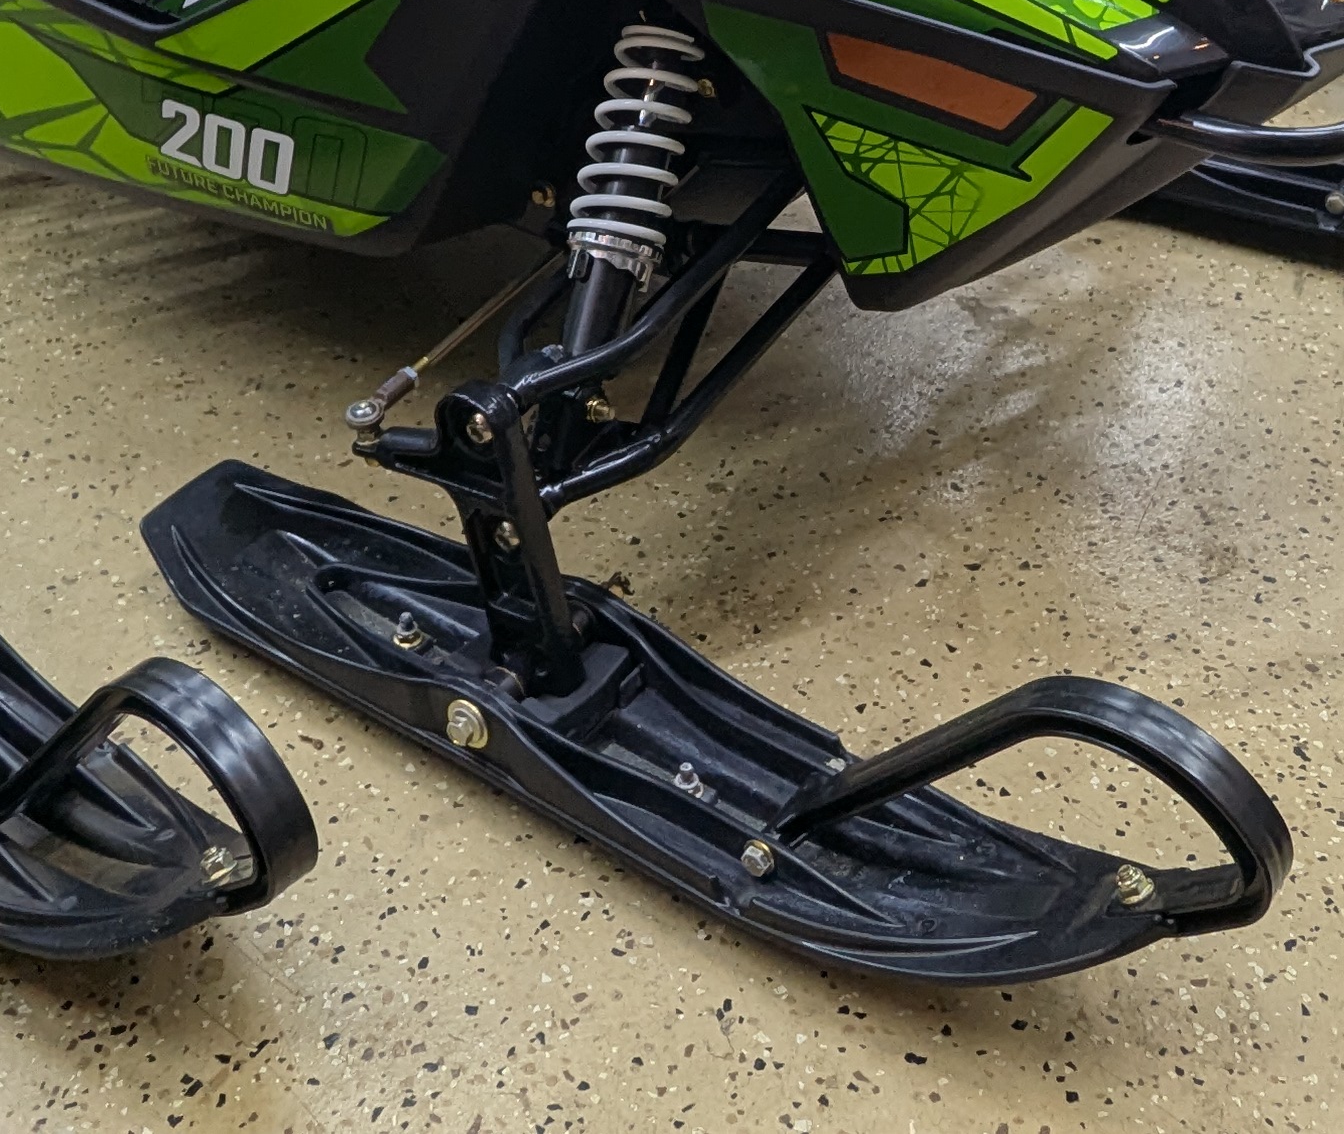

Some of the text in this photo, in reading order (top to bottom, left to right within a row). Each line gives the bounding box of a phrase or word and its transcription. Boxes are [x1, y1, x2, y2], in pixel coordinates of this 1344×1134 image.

[160, 98, 295, 195] 200
[146, 155, 329, 231] FUTURE CHAMPION
